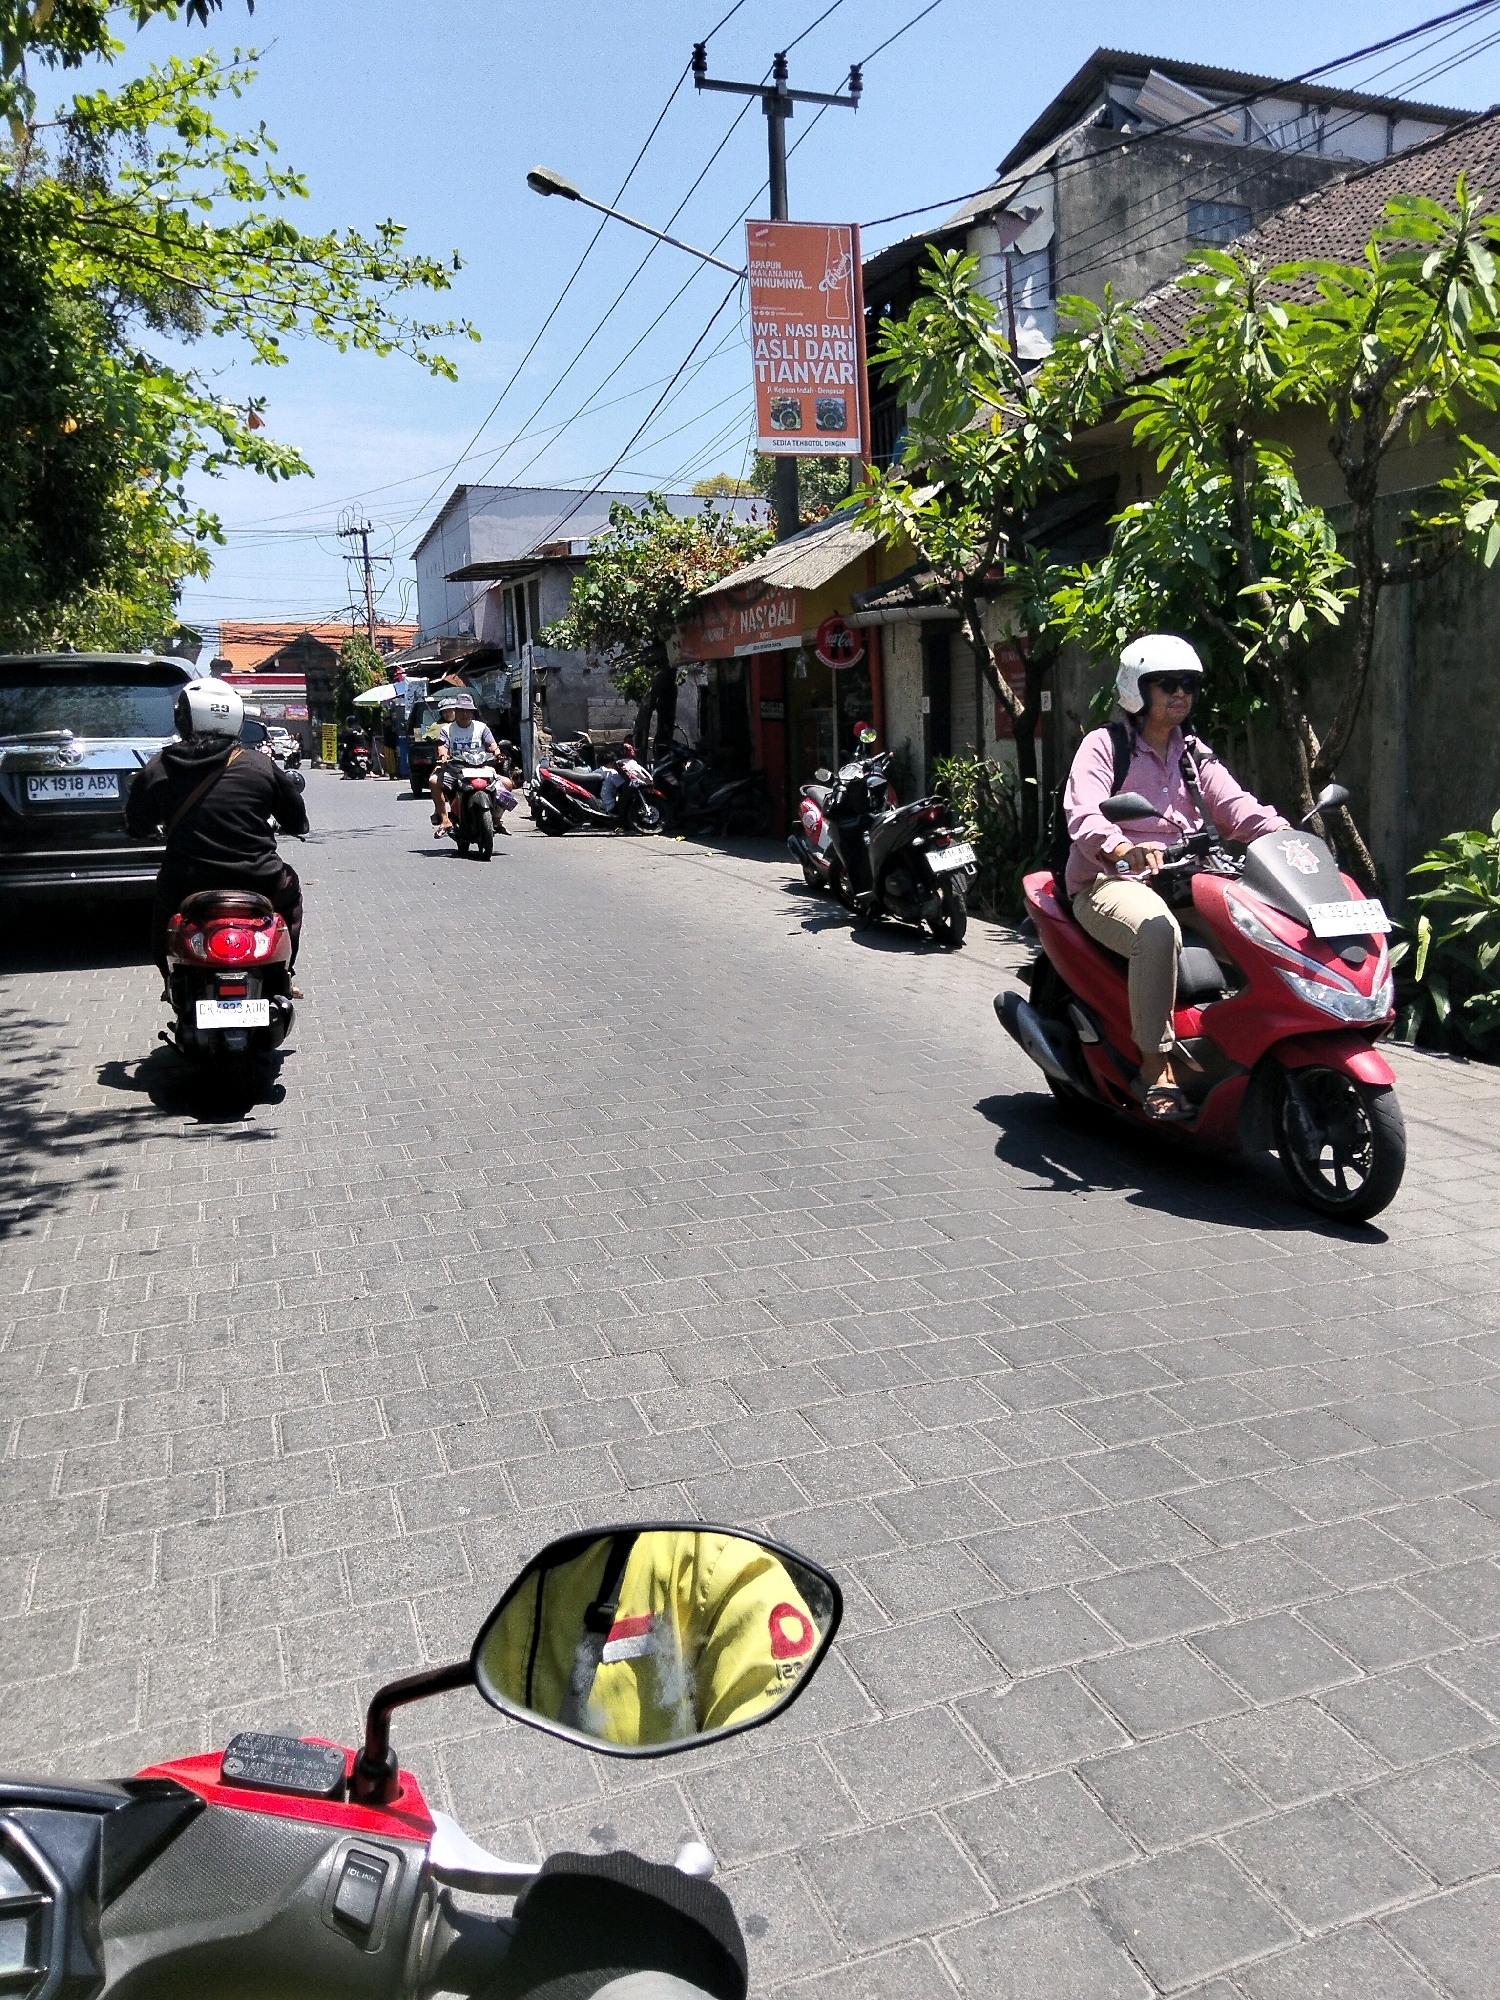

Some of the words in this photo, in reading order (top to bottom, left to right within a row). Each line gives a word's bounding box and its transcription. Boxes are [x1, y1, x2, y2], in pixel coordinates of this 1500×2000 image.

[751, 261, 781, 269] APAPUN
[751, 270, 803, 278] MAKANANNYA
[753, 322, 782, 336] WR.
[785, 323, 817, 338] NASI
[821, 324, 853, 339] BALI
[755, 339, 799, 359] ASLI
[805, 340, 854, 361] DARI
[754, 360, 855, 385] TIANYAR
[767, 598, 796, 628] BALI
[210, 703, 230, 713] 29
[30, 778, 48, 791] DK
[51, 777, 84, 790] 1918
[88, 776, 117, 789] ABX
[1308, 905, 1327, 919] DK
[1328, 904, 1358, 918] 3924
[200, 1003, 214, 1015] DK
